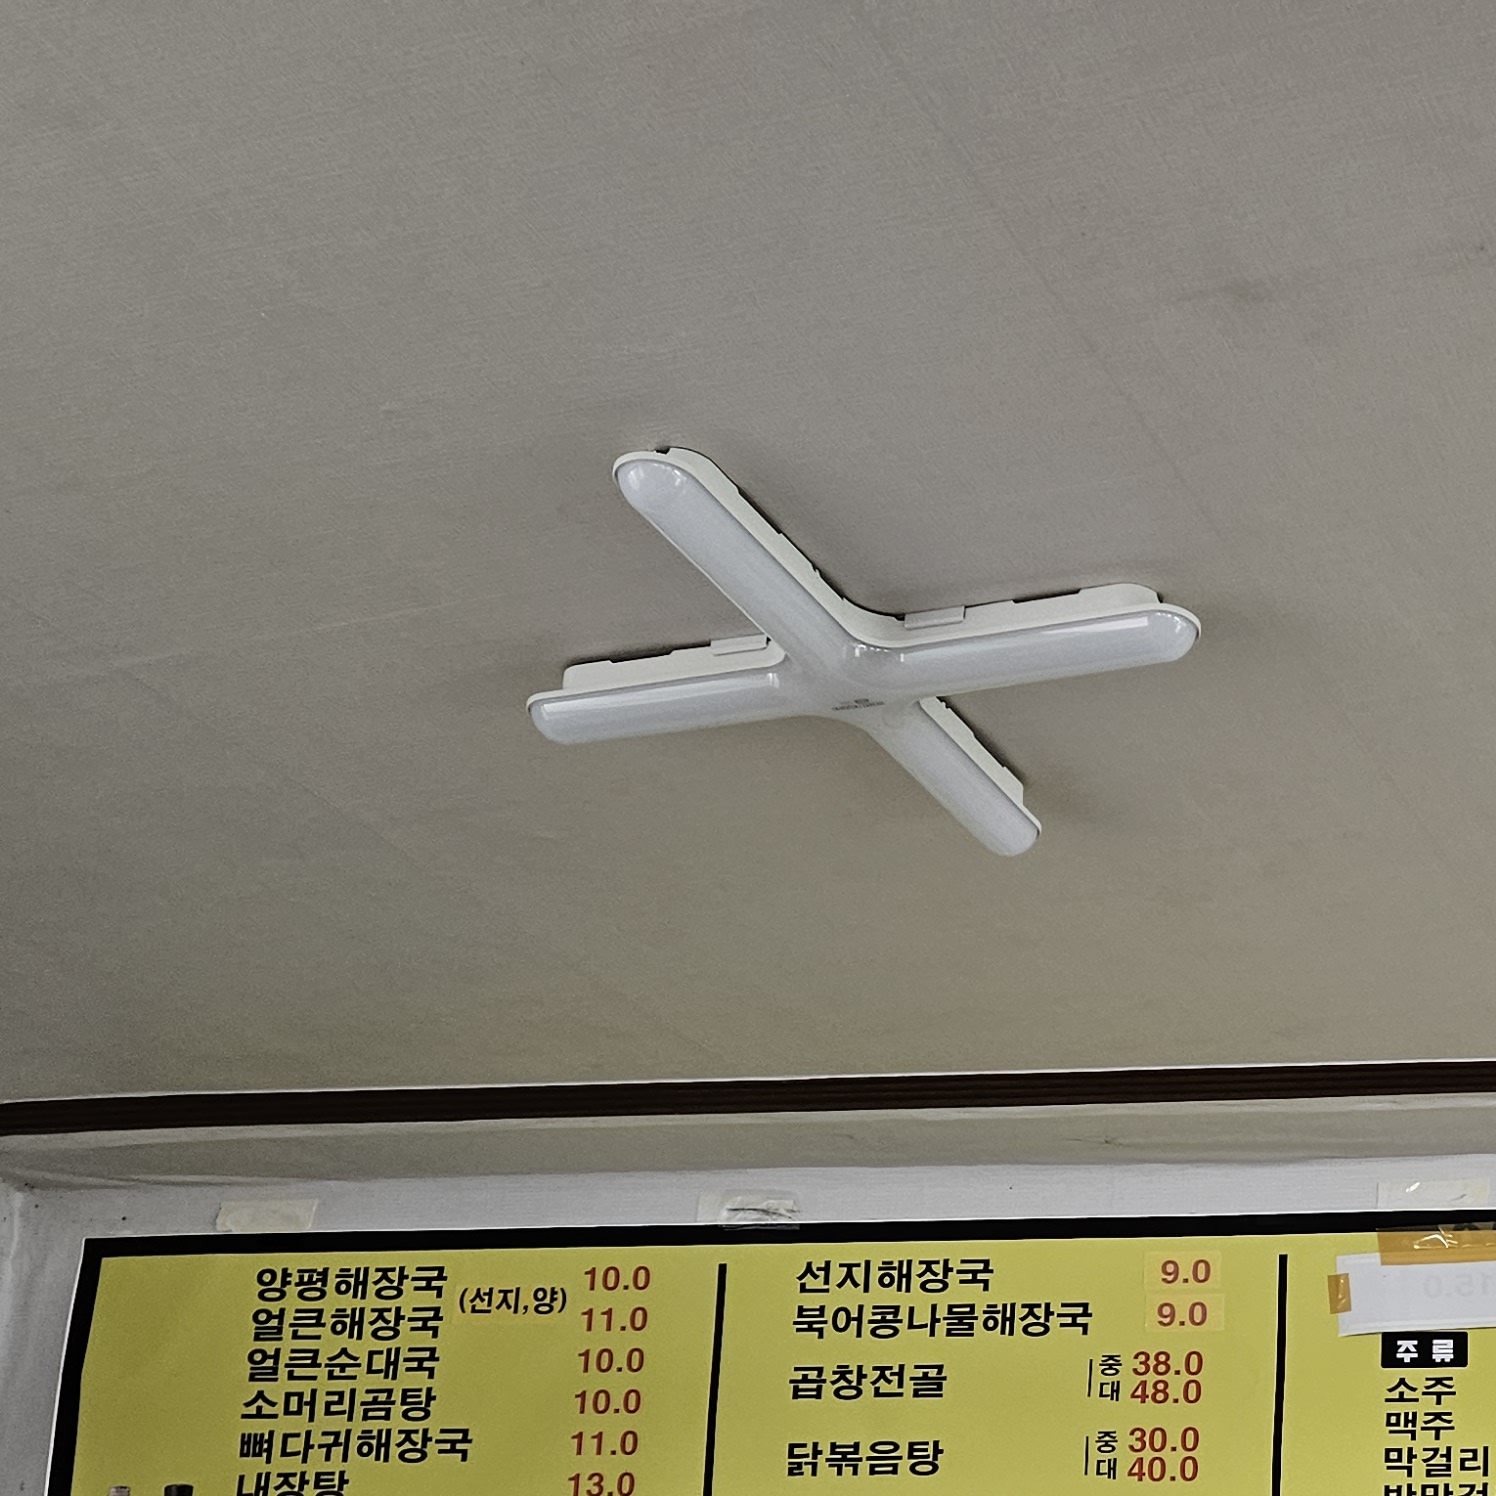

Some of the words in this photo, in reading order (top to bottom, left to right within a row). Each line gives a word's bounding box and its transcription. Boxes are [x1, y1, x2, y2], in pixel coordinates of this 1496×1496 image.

[256, 1265, 448, 1303] 양평해장국
[459, 1286, 567, 1315] (선지,양)
[584, 1266, 651, 1291] 10.0
[795, 1258, 994, 1294] 선지해장국
[1160, 1259, 1212, 1285] 9.0
[251, 1305, 444, 1342] 얼큰해장국
[579, 1306, 648, 1331] 11.0
[792, 1301, 1093, 1340] 북어콩나물해장국
[1156, 1301, 1209, 1327] 9.0
[247, 1346, 440, 1383] 얼큰순대국
[577, 1347, 644, 1373] 10.0
[788, 1363, 948, 1401] 곱창전골
[1098, 1354, 1123, 1377] 중
[1132, 1350, 1204, 1377] 38.0
[240, 1386, 437, 1424] 소머리곰탕
[574, 1388, 642, 1414] 10.0
[1098, 1380, 1121, 1402] 대
[1130, 1378, 1203, 1405] 48.0
[1384, 1376, 1457, 1406] 소주
[1385, 1411, 1455, 1441] 맥주
[239, 1427, 474, 1465] 뼈다귀해장국
[570, 1430, 638, 1456] 11.0
[787, 1439, 945, 1477] 닭볶음탕
[1094, 1430, 1119, 1454] 중
[1128, 1426, 1200, 1454] 30.0
[1384, 1445, 1489, 1478] 막걸리
[1095, 1457, 1118, 1480] 대
[1127, 1455, 1200, 1483] 40.0
